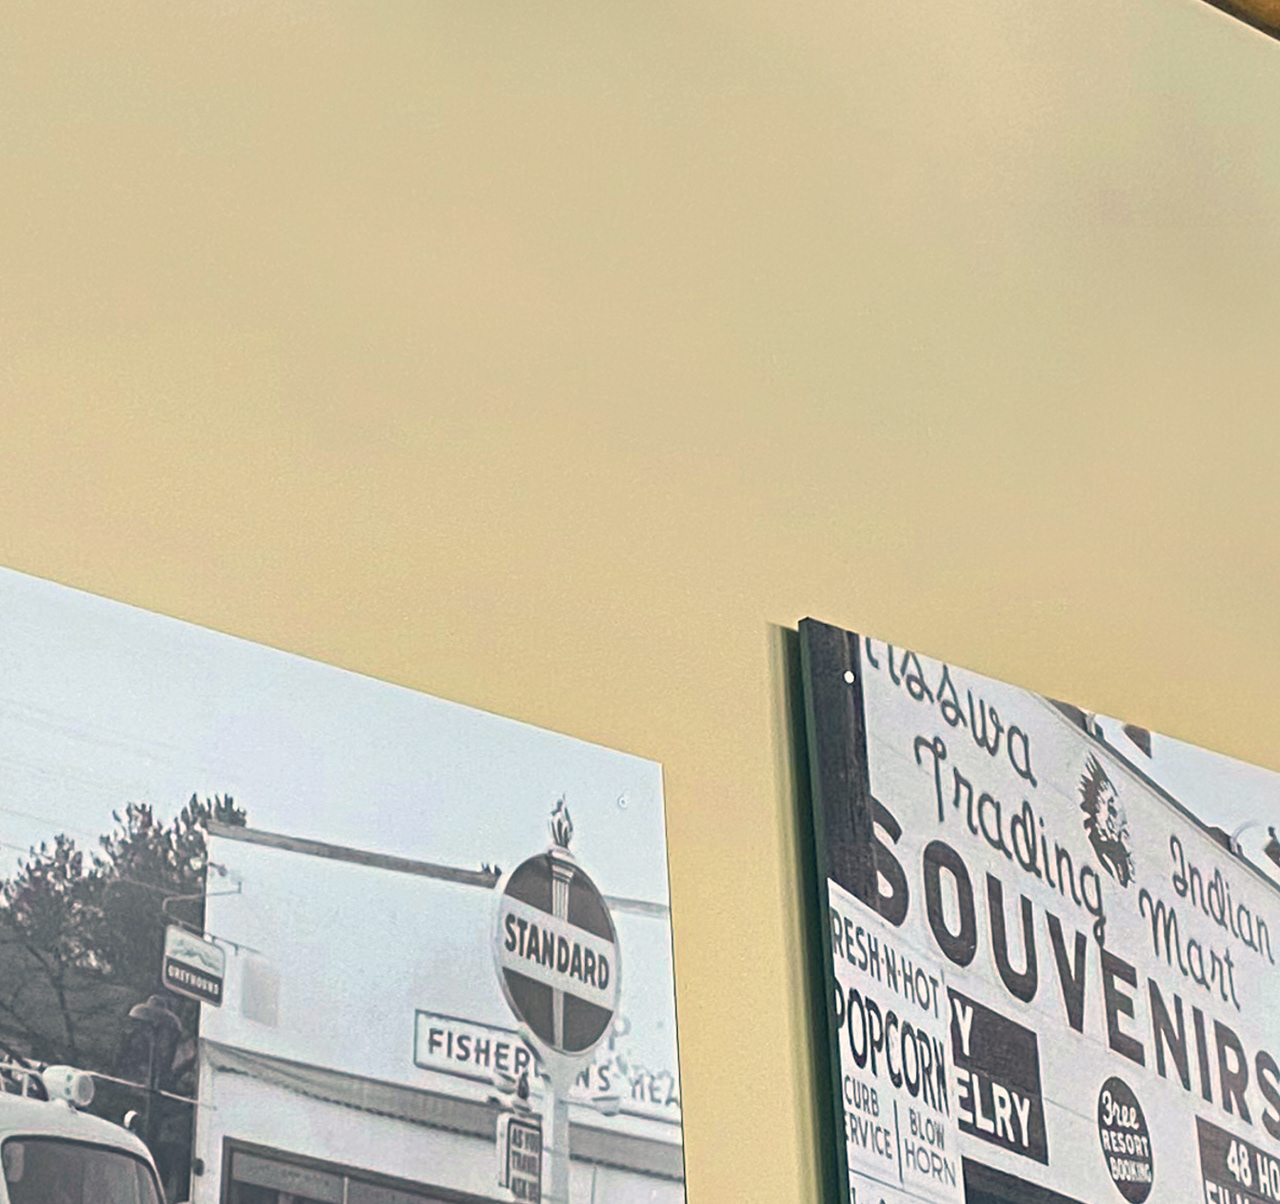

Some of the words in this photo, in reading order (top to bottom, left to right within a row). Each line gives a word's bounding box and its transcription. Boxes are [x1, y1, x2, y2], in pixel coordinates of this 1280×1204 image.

[914, 735, 1108, 950] Trading
[1170, 835, 1275, 965] Indian
[503, 912, 610, 991] STANDARD
[1138, 888, 1240, 1012] Mart
[844, 1074, 880, 1118] CURB
[1102, 1090, 1140, 1131] Free
[909, 1107, 946, 1152] BLOW
[1100, 1128, 1149, 1158] RESORT
[903, 1144, 957, 1189] HORN
[1226, 1139, 1252, 1187] 48
